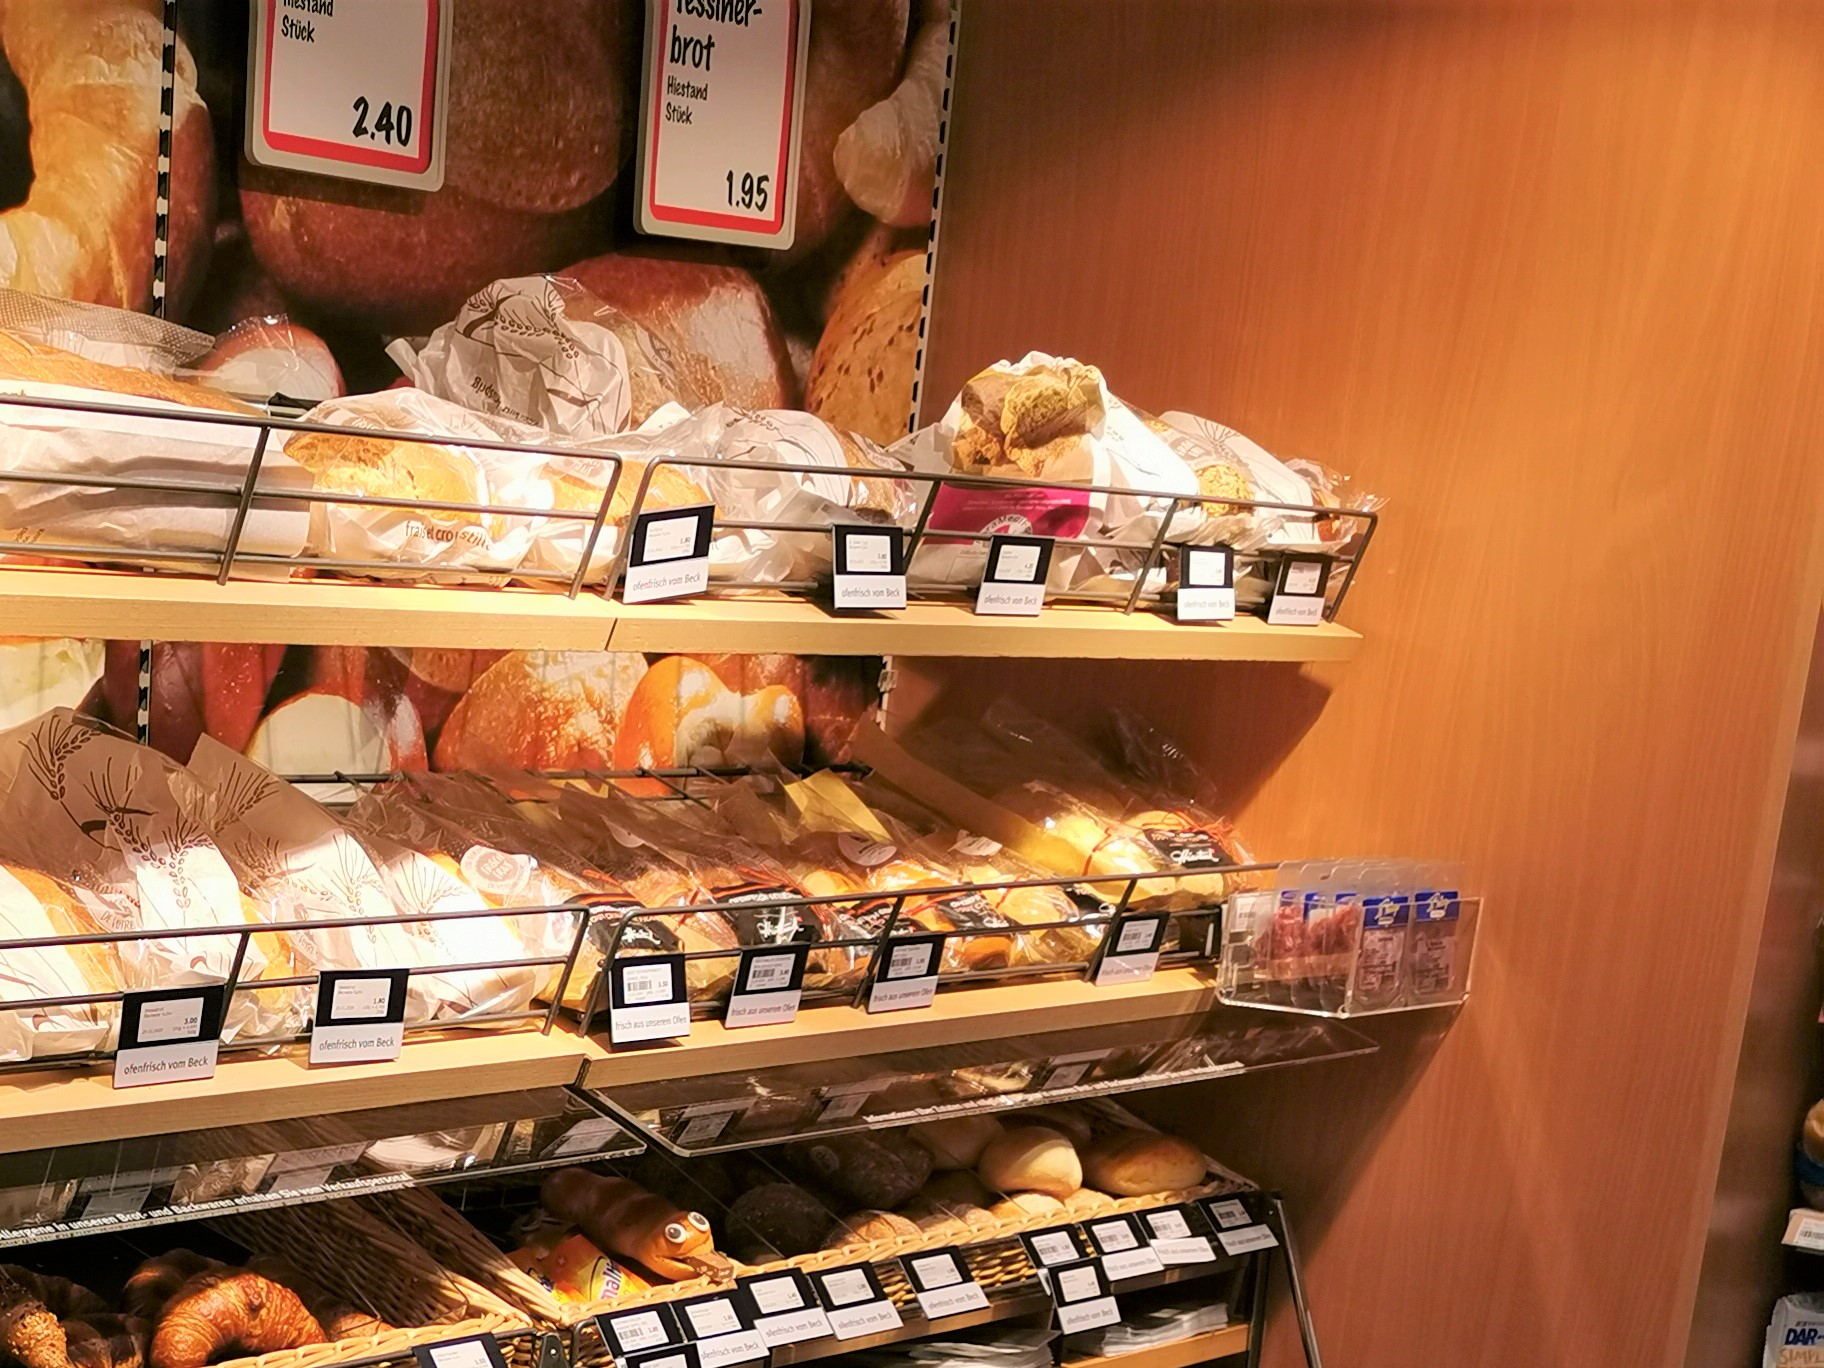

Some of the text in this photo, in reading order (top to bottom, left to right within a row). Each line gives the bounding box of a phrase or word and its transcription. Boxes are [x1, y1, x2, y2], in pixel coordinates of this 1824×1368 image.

[281, 15, 315, 43] Stück
[670, 24, 715, 72] brot
[667, 75, 708, 101] Hiestand
[352, 96, 412, 147] 2.40
[665, 101, 693, 125] Stück
[726, 169, 771, 214] 1.95
[319, 1036, 357, 1052] ofenfrisch
[376, 1036, 395, 1048] Beck
[124, 1055, 209, 1075] ofenfrisch vom Beck
